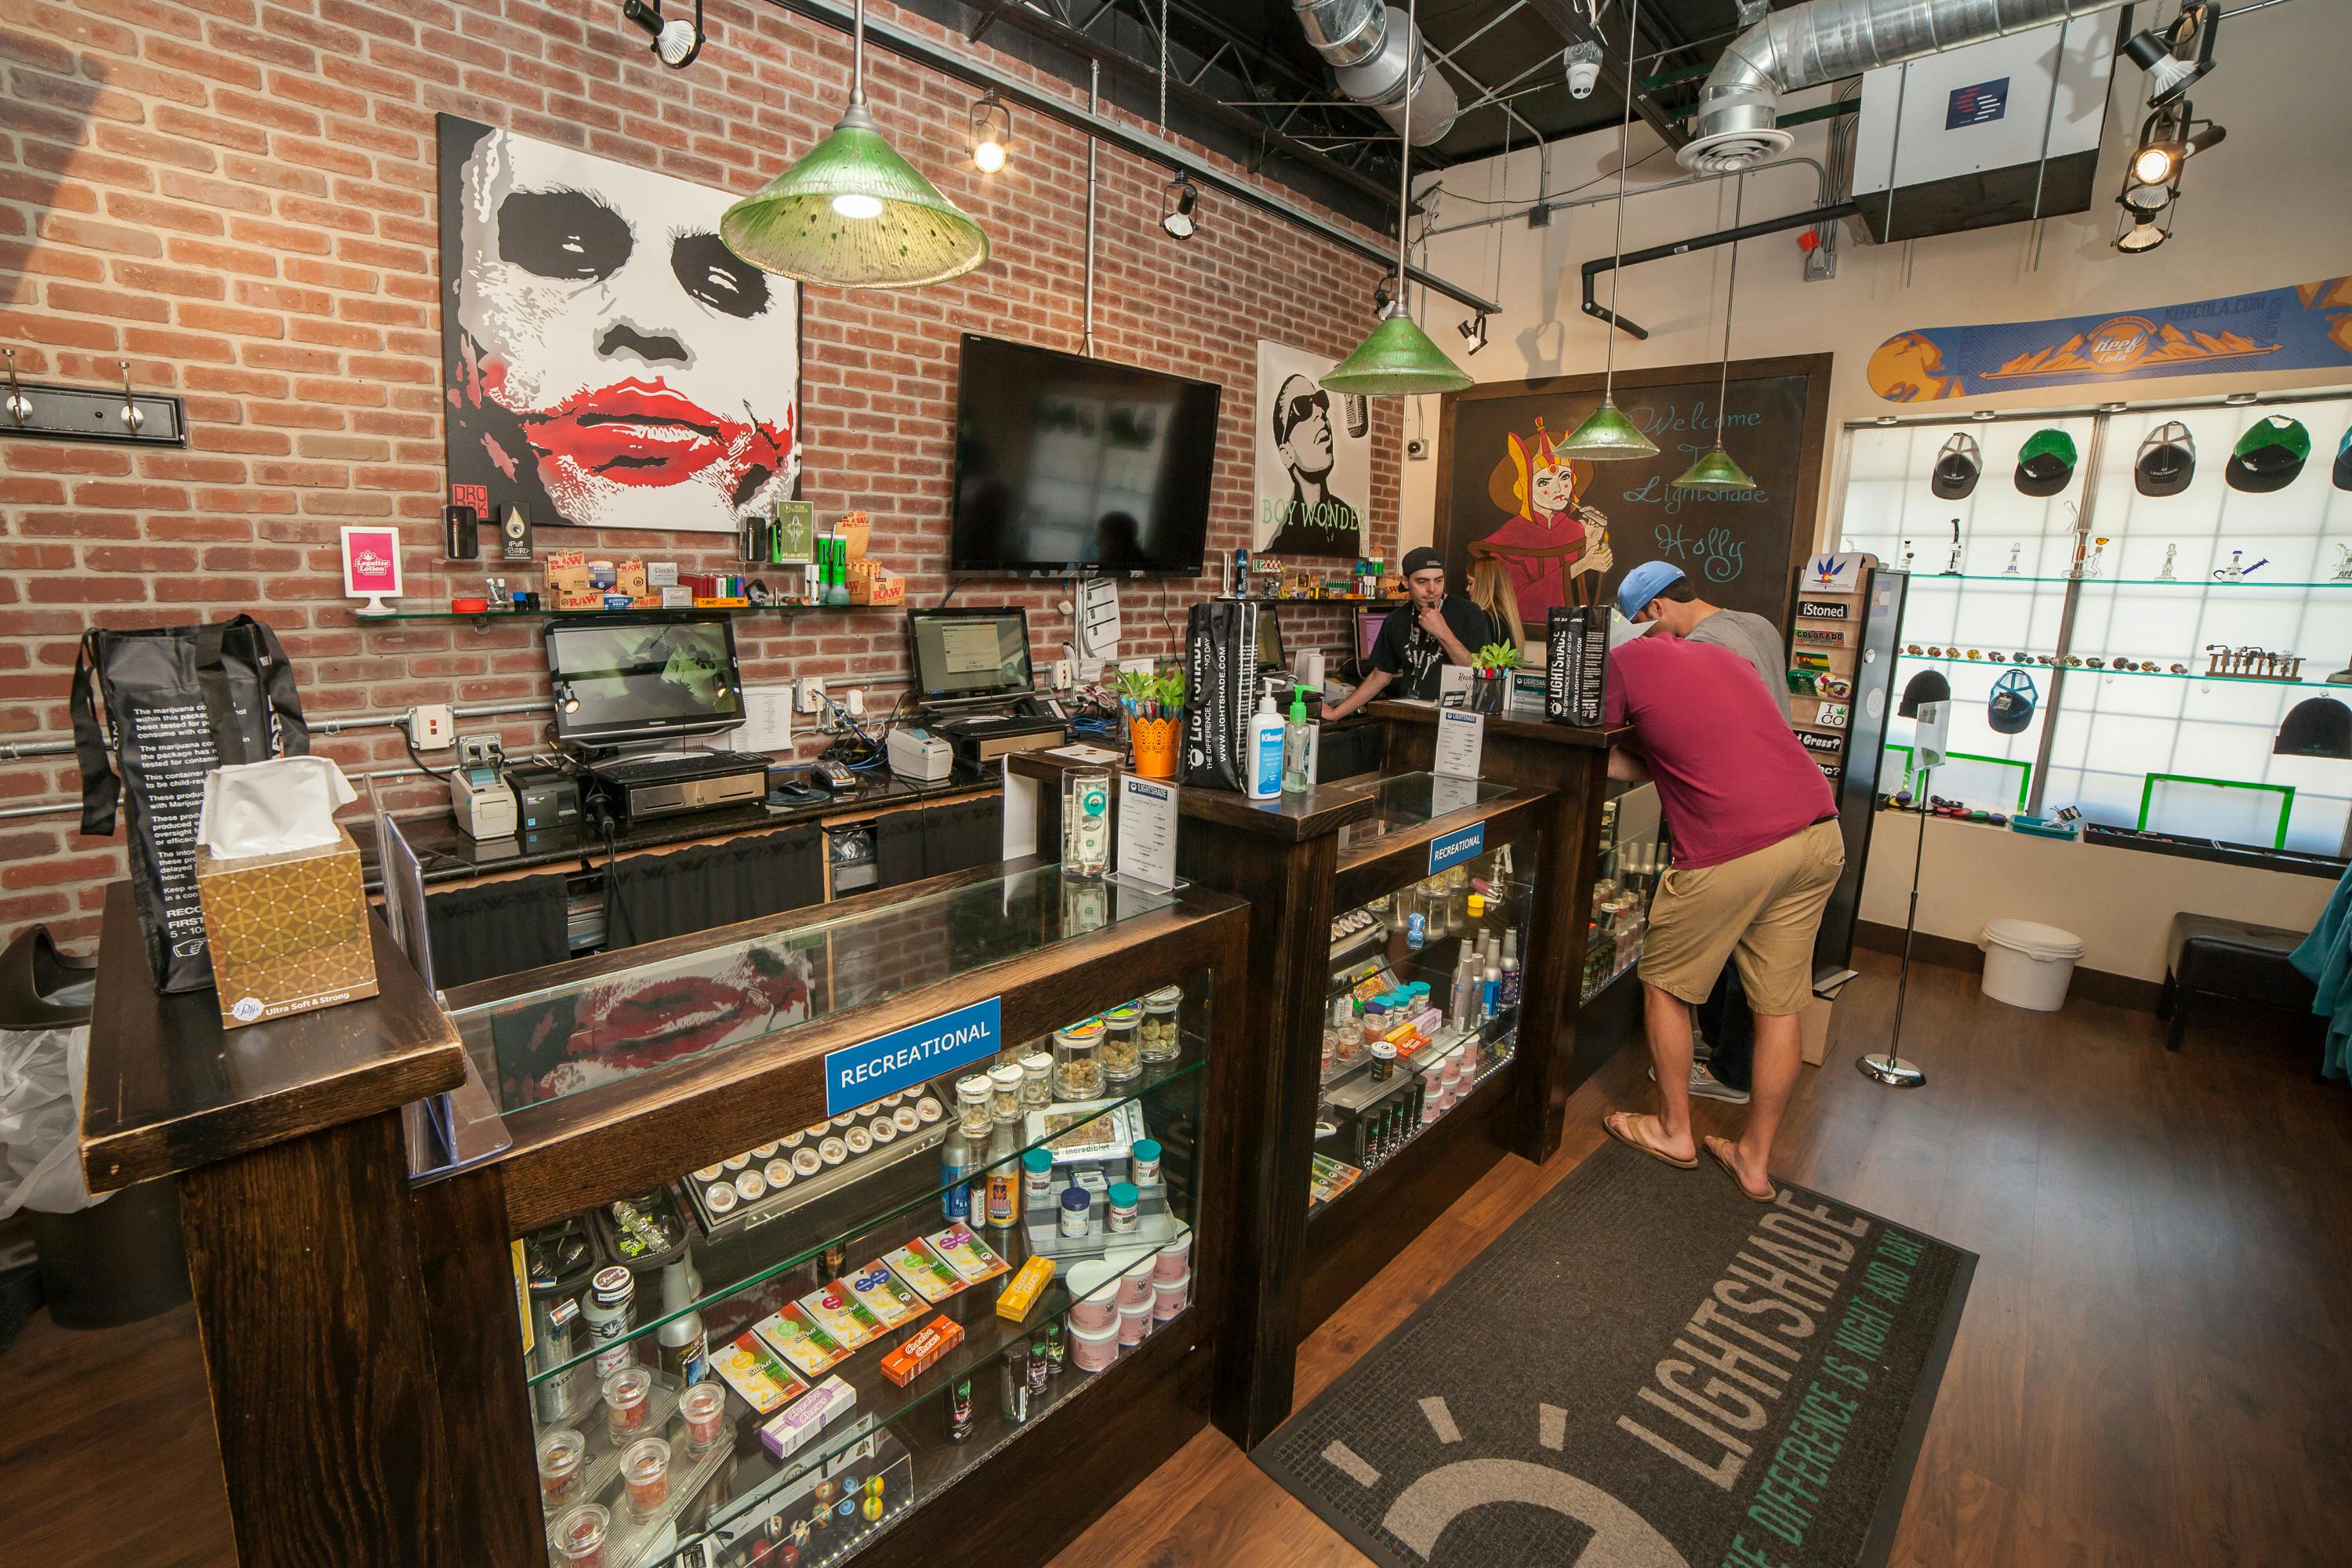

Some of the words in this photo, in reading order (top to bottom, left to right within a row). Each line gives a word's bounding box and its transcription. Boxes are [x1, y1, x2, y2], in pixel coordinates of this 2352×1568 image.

[842, 516, 867, 528] RAW
[1261, 499, 1298, 526] BOY
[1301, 501, 1367, 532] WONDER
[1654, 524, 1746, 583] Holly
[549, 555, 583, 570] RAW
[844, 581, 859, 590] AW
[568, 594, 597, 607] RAW
[873, 587, 902, 600] RAW
[1803, 603, 1844, 618] iStoned
[1797, 630, 1843, 641] COLORADO
[1573, 637, 1583, 713] WWW.LIGHTSHADE.COM
[154, 706, 194, 715] marijuana
[1453, 713, 1476, 722] LIGHTSHADE
[136, 723, 158, 731] been
[160, 721, 187, 730] tested
[1821, 714, 1845, 726] CO
[137, 730, 176, 739] consume
[1261, 732, 1283, 742] Kleenex
[158, 742, 200, 751] marijuana
[1803, 735, 1841, 749] Grass?
[157, 750, 193, 760] package
[142, 760, 169, 769] tested
[165, 771, 204, 780] container
[169, 778, 206, 787] child-res
[148, 793, 174, 802] These
[176, 791, 205, 800] produc
[1138, 783, 1167, 799] LIGHTSHADE
[169, 800, 203, 808] Marijuan
[153, 822, 192, 831] produced
[154, 829, 193, 838] oversight
[1435, 834, 1480, 862] RECREATIONAL
[160, 865, 193, 874] delayed
[163, 886, 186, 895] Keep
[265, 1005, 290, 1016] Ultra
[291, 1000, 310, 1011] Soft
[319, 992, 350, 1004] Strong
[840, 1021, 990, 1088] RECREATIONAL
[1876, 1229, 1926, 1267] DAY
[918, 1260, 939, 1274] Sucker
[1860, 1261, 1912, 1305] AND
[837, 1302, 861, 1318] Sucker
[794, 1326, 817, 1343] Sucker
[1831, 1294, 1896, 1363] NIGHT
[905, 1328, 935, 1355] Cheeba
[915, 1334, 941, 1357] Chews
[1615, 1189, 1871, 1491] LIGHTSHADE
[748, 1358, 773, 1377] Sucker
[1819, 1355, 1871, 1392] IS
[788, 1390, 822, 1420] Cheeba
[799, 1396, 829, 1424] Chews
[1748, 1381, 1860, 1548] DIFFERENCE
